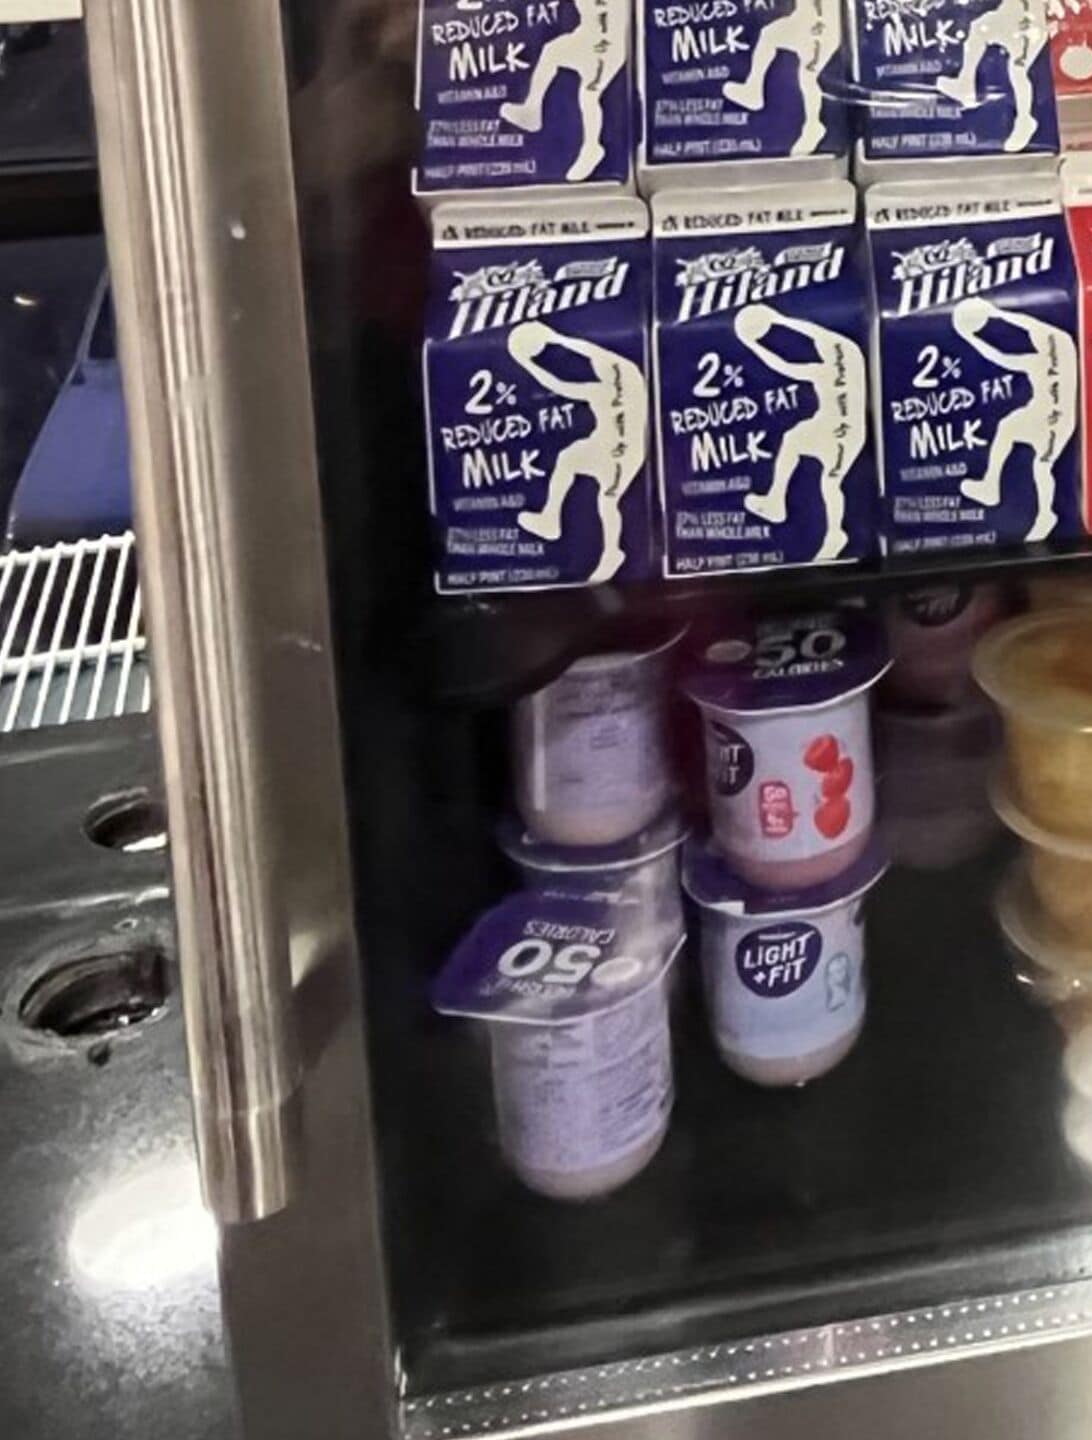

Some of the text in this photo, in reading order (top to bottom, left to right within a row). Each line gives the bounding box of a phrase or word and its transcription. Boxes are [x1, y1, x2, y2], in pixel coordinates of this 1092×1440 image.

[431, 0, 560, 45] REDUCED FAT
[653, 0, 738, 29] REDUCED
[449, 42, 531, 82] MILK
[671, 24, 750, 63] MILK
[675, 245, 845, 326] Hiland
[891, 234, 1054, 317] Hiland
[692, 351, 745, 398] 2%
[912, 344, 963, 388] 2%
[464, 369, 517, 414] 2%
[670, 384, 799, 435] REDUCED FAT
[891, 375, 1013, 423] REDUCED FAT
[440, 403, 575, 452] REDUCED FAT
[909, 419, 988, 459] MILK
[462, 449, 546, 488] MILK
[691, 430, 773, 472] MILK
[752, 657, 845, 680] CALORIES
[754, 628, 847, 668] 50
[522, 919, 616, 945] CALORIES
[743, 930, 816, 970] LIGHT
[497, 938, 601, 985] 50
